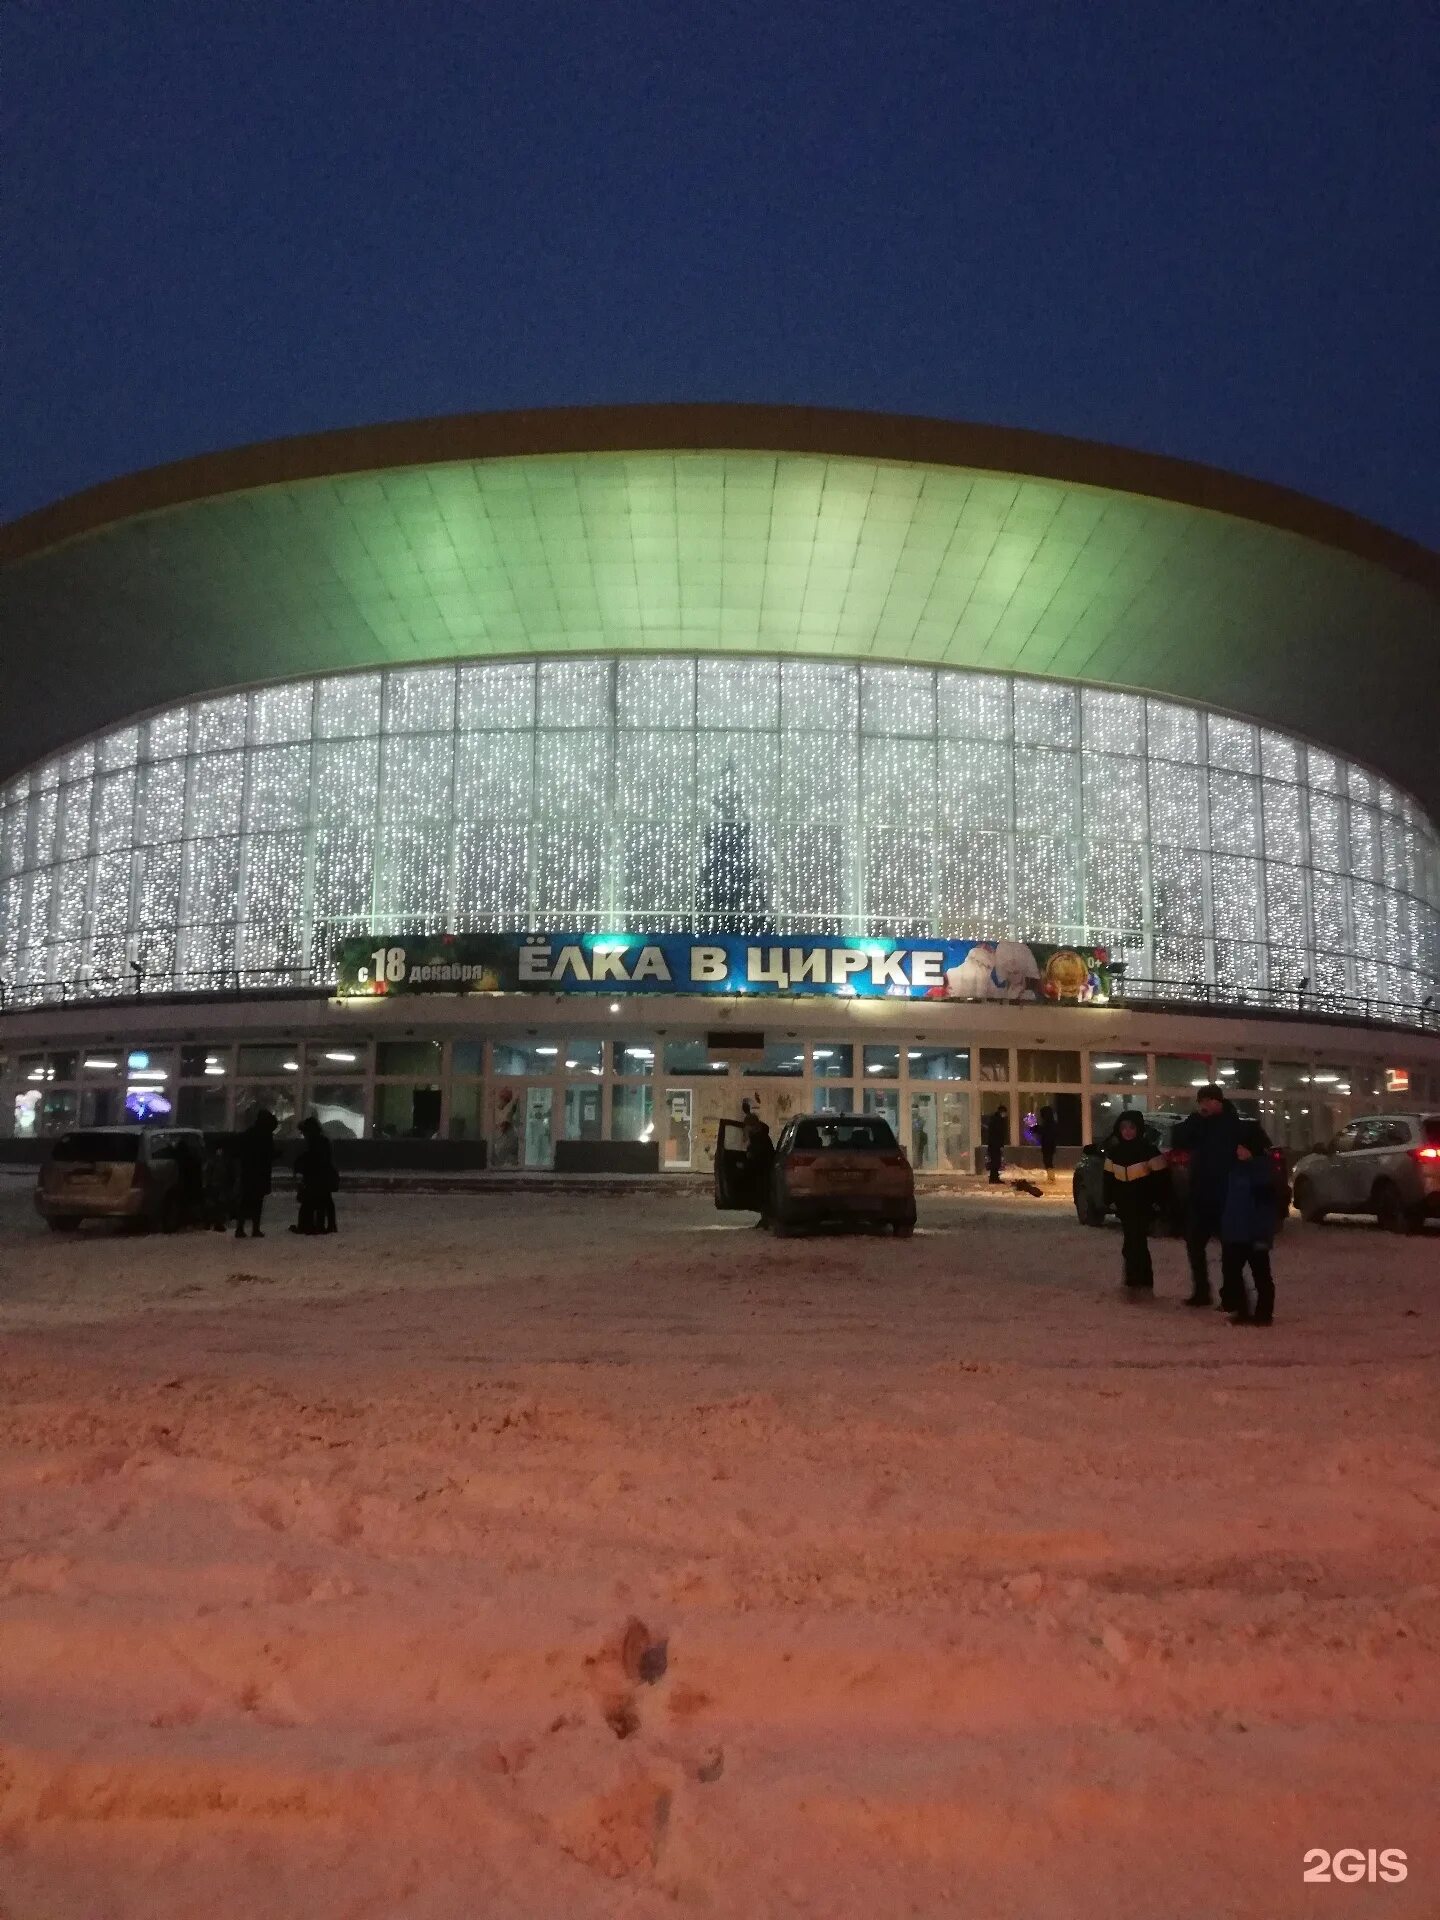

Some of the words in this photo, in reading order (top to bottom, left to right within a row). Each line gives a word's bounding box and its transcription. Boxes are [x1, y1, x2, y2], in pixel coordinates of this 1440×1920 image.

[371, 947, 406, 982] 18
[408, 962, 483, 984] декабря
[518, 936, 672, 982] ЁЛКА
[690, 946, 729, 981] В
[747, 946, 945, 989] ЦИРКЕ
